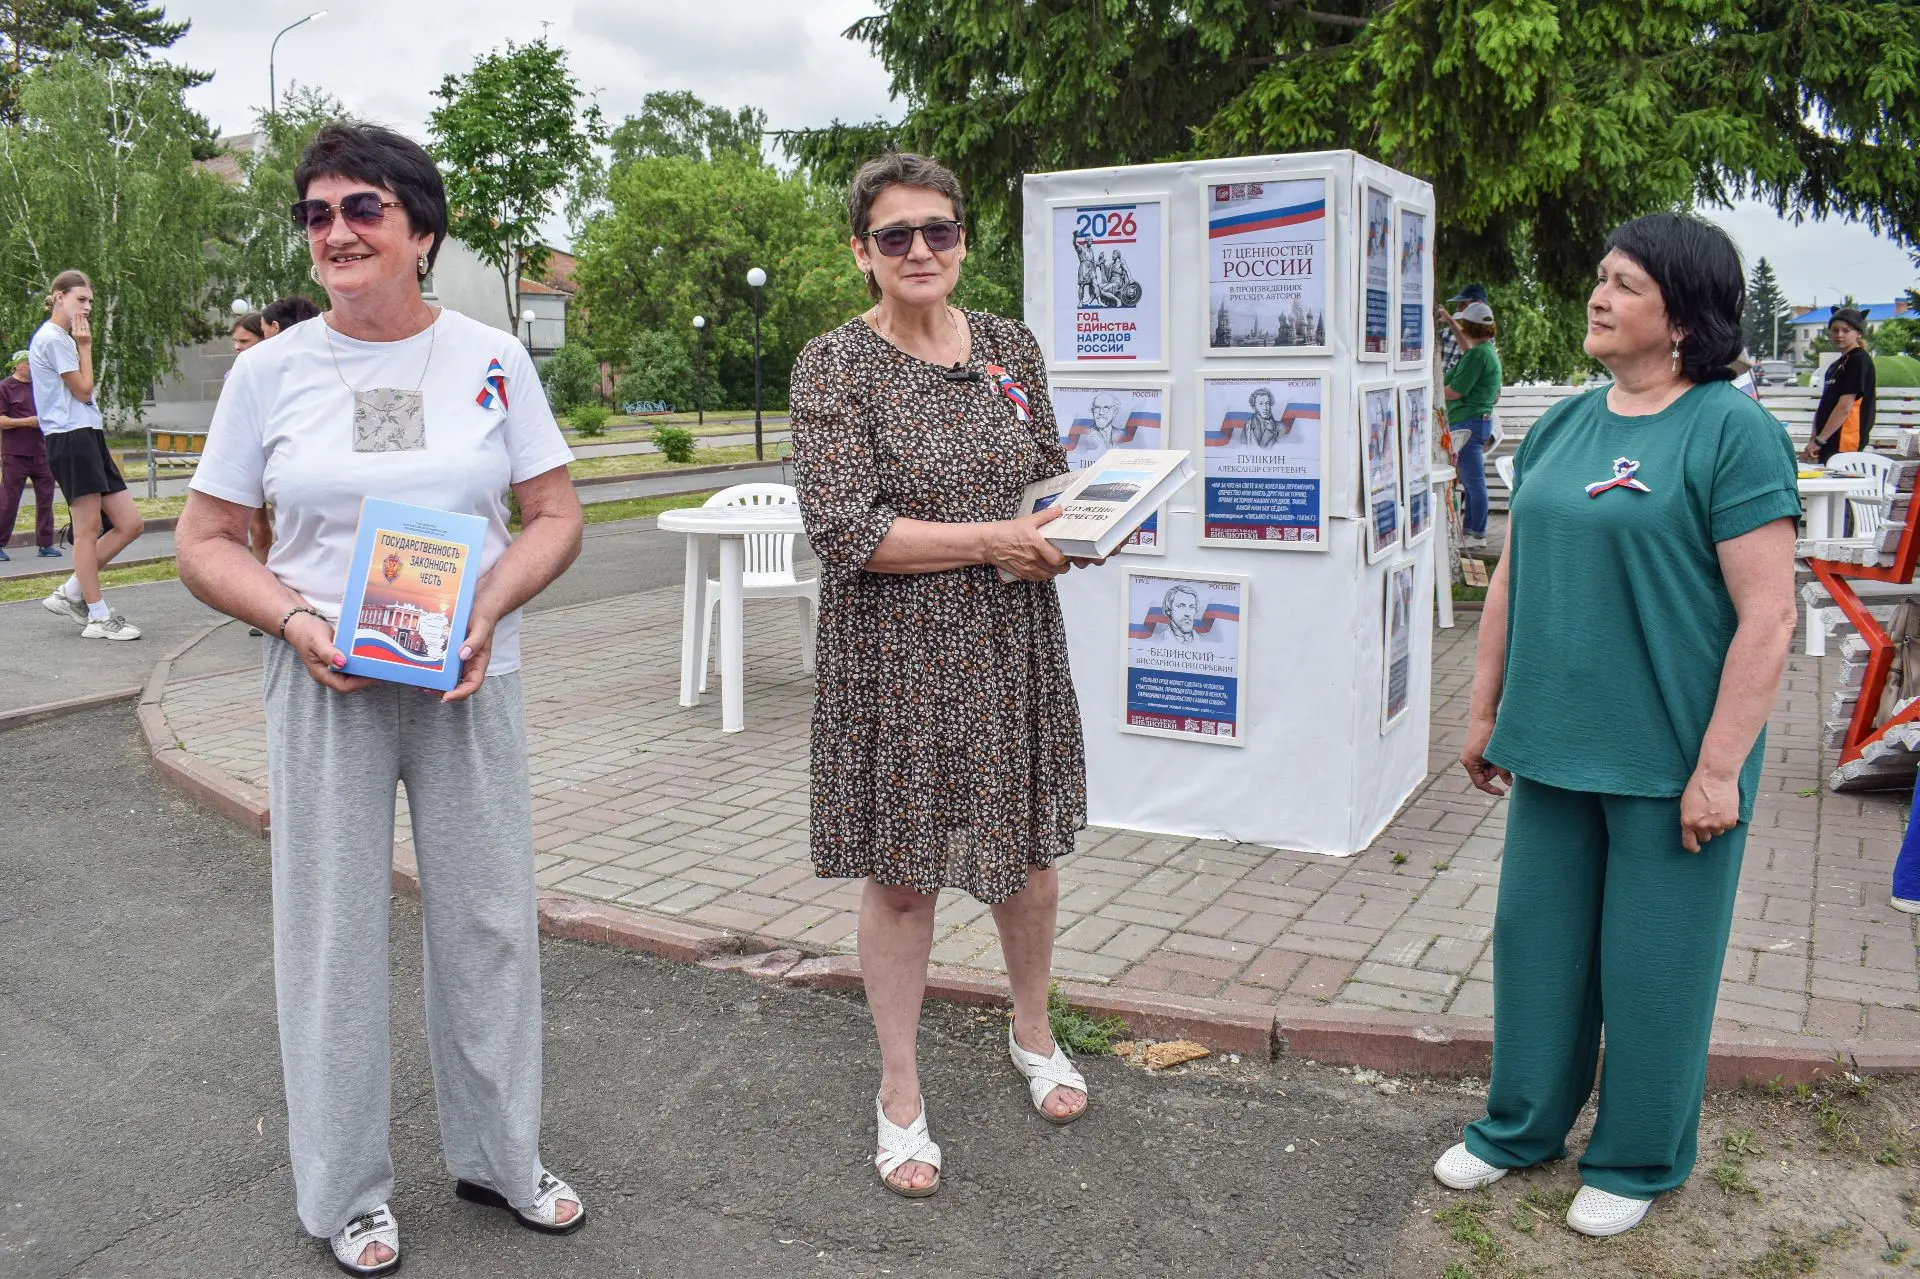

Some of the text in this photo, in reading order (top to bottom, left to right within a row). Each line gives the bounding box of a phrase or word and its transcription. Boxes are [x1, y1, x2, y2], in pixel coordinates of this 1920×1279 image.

[1077, 212, 1137, 237] 2026
[1222, 243, 1313, 260] 17 ЦЕННОСТЕЙ
[1223, 258, 1313, 278] РОССИИ
[1236, 284, 1302, 293] ПРОИЗВЕДЕНИЯХ
[1230, 291, 1302, 301] РУССКИХ АВТОРОВ
[1077, 312, 1099, 323] ГОД
[1077, 321, 1137, 333] ЕДИНСТВА
[1077, 332, 1131, 343] НАРОДОВ
[1077, 343, 1124, 353] РОССИИ
[1288, 380, 1317, 388] РОССИИ
[1237, 454, 1285, 464] ПУШКИН
[1217, 465, 1307, 474] АЛЕКСАНДР СЕРГЕЕВИЧ
[1064, 505, 1116, 513] СЛУЖЕНИ
[1210, 532, 1258, 540] БИБЛИОТЕКИ
[381, 534, 461, 559] ГОСУДАРСТВЕННОСТЬ
[410, 557, 457, 574] ЗАКОННОСТЬ
[419, 573, 443, 587] ЧЕСТЬ
[1208, 583, 1236, 591] РОССИИ
[1150, 647, 1214, 661] БЕЛИНСКИЙ
[1136, 658, 1233, 673] ВИССАРИОН ГРИГОРЬЕВИЧ
[1132, 719, 1177, 730] БИБЛИОТЕКИ
